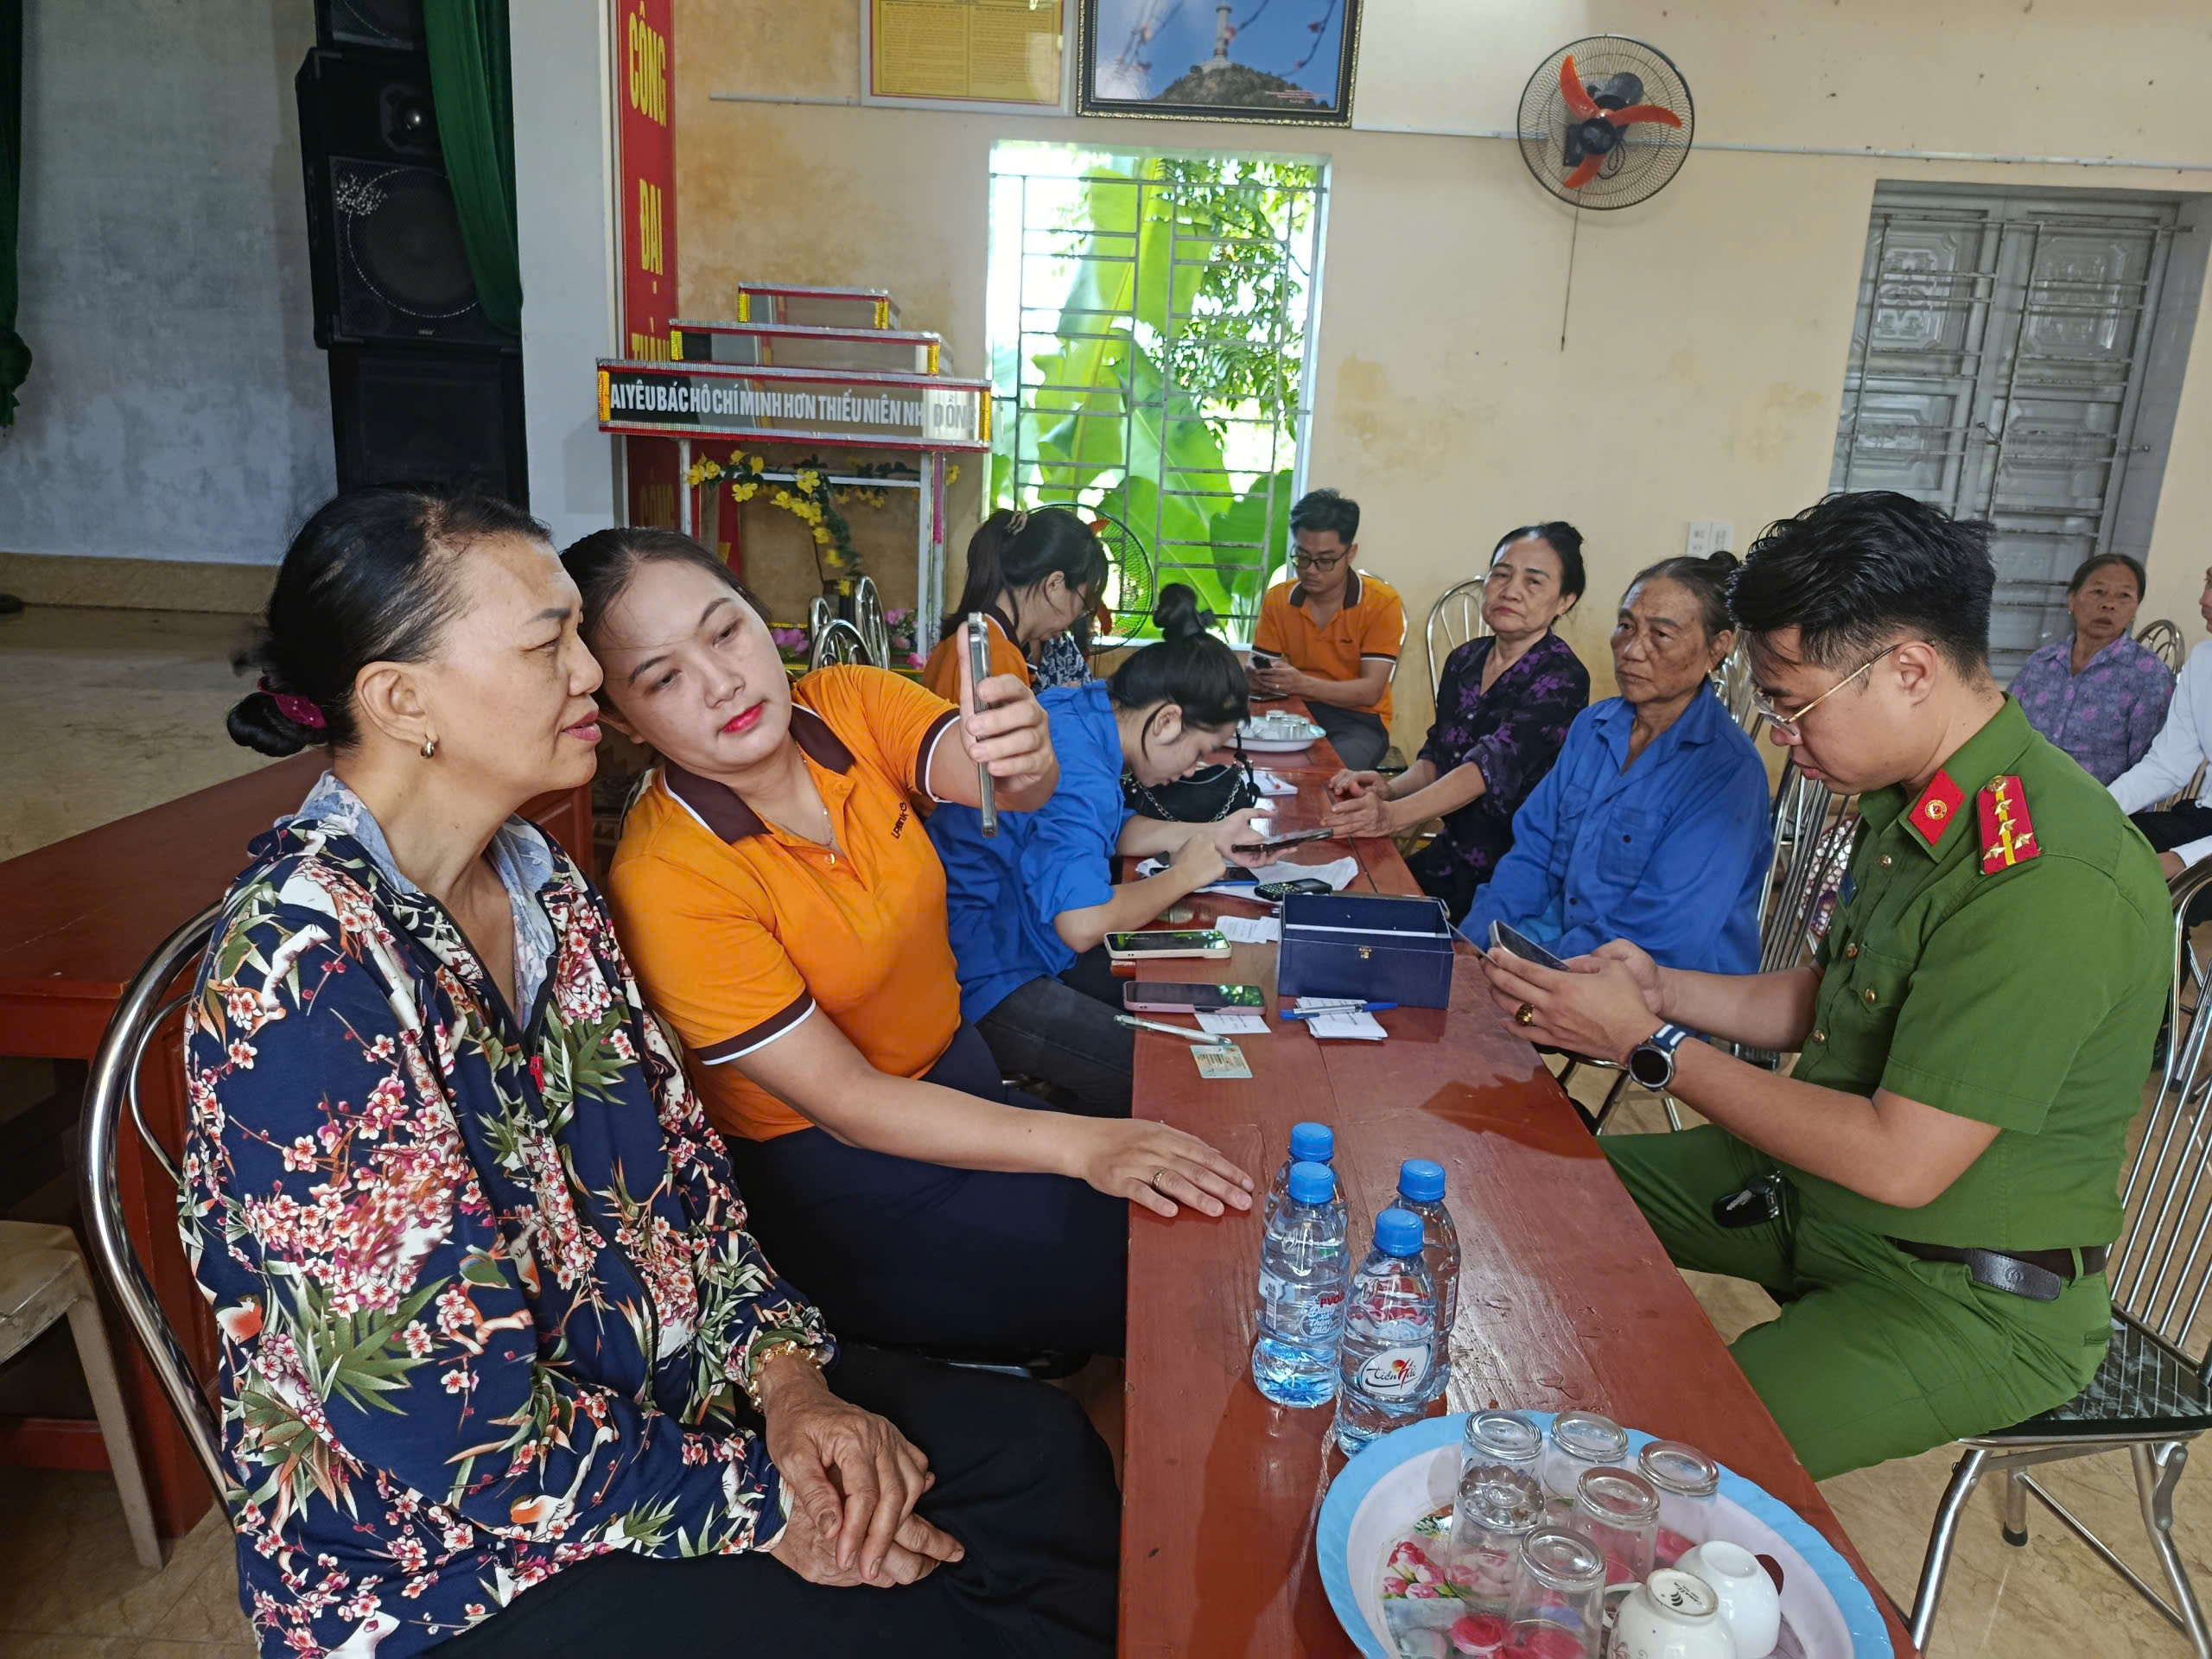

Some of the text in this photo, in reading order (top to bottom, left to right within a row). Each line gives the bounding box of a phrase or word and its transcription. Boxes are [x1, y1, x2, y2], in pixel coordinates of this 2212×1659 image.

[626, 378, 656, 411] YÊU
[657, 380, 689, 413] BÁC
[712, 384, 739, 415] CHÍ
[740, 391, 782, 418] MINH
[784, 391, 817, 420] HƠN
[817, 388, 862, 423] THIẾU
[864, 393, 901, 425] NIÊN
[902, 400, 927, 427] NH
